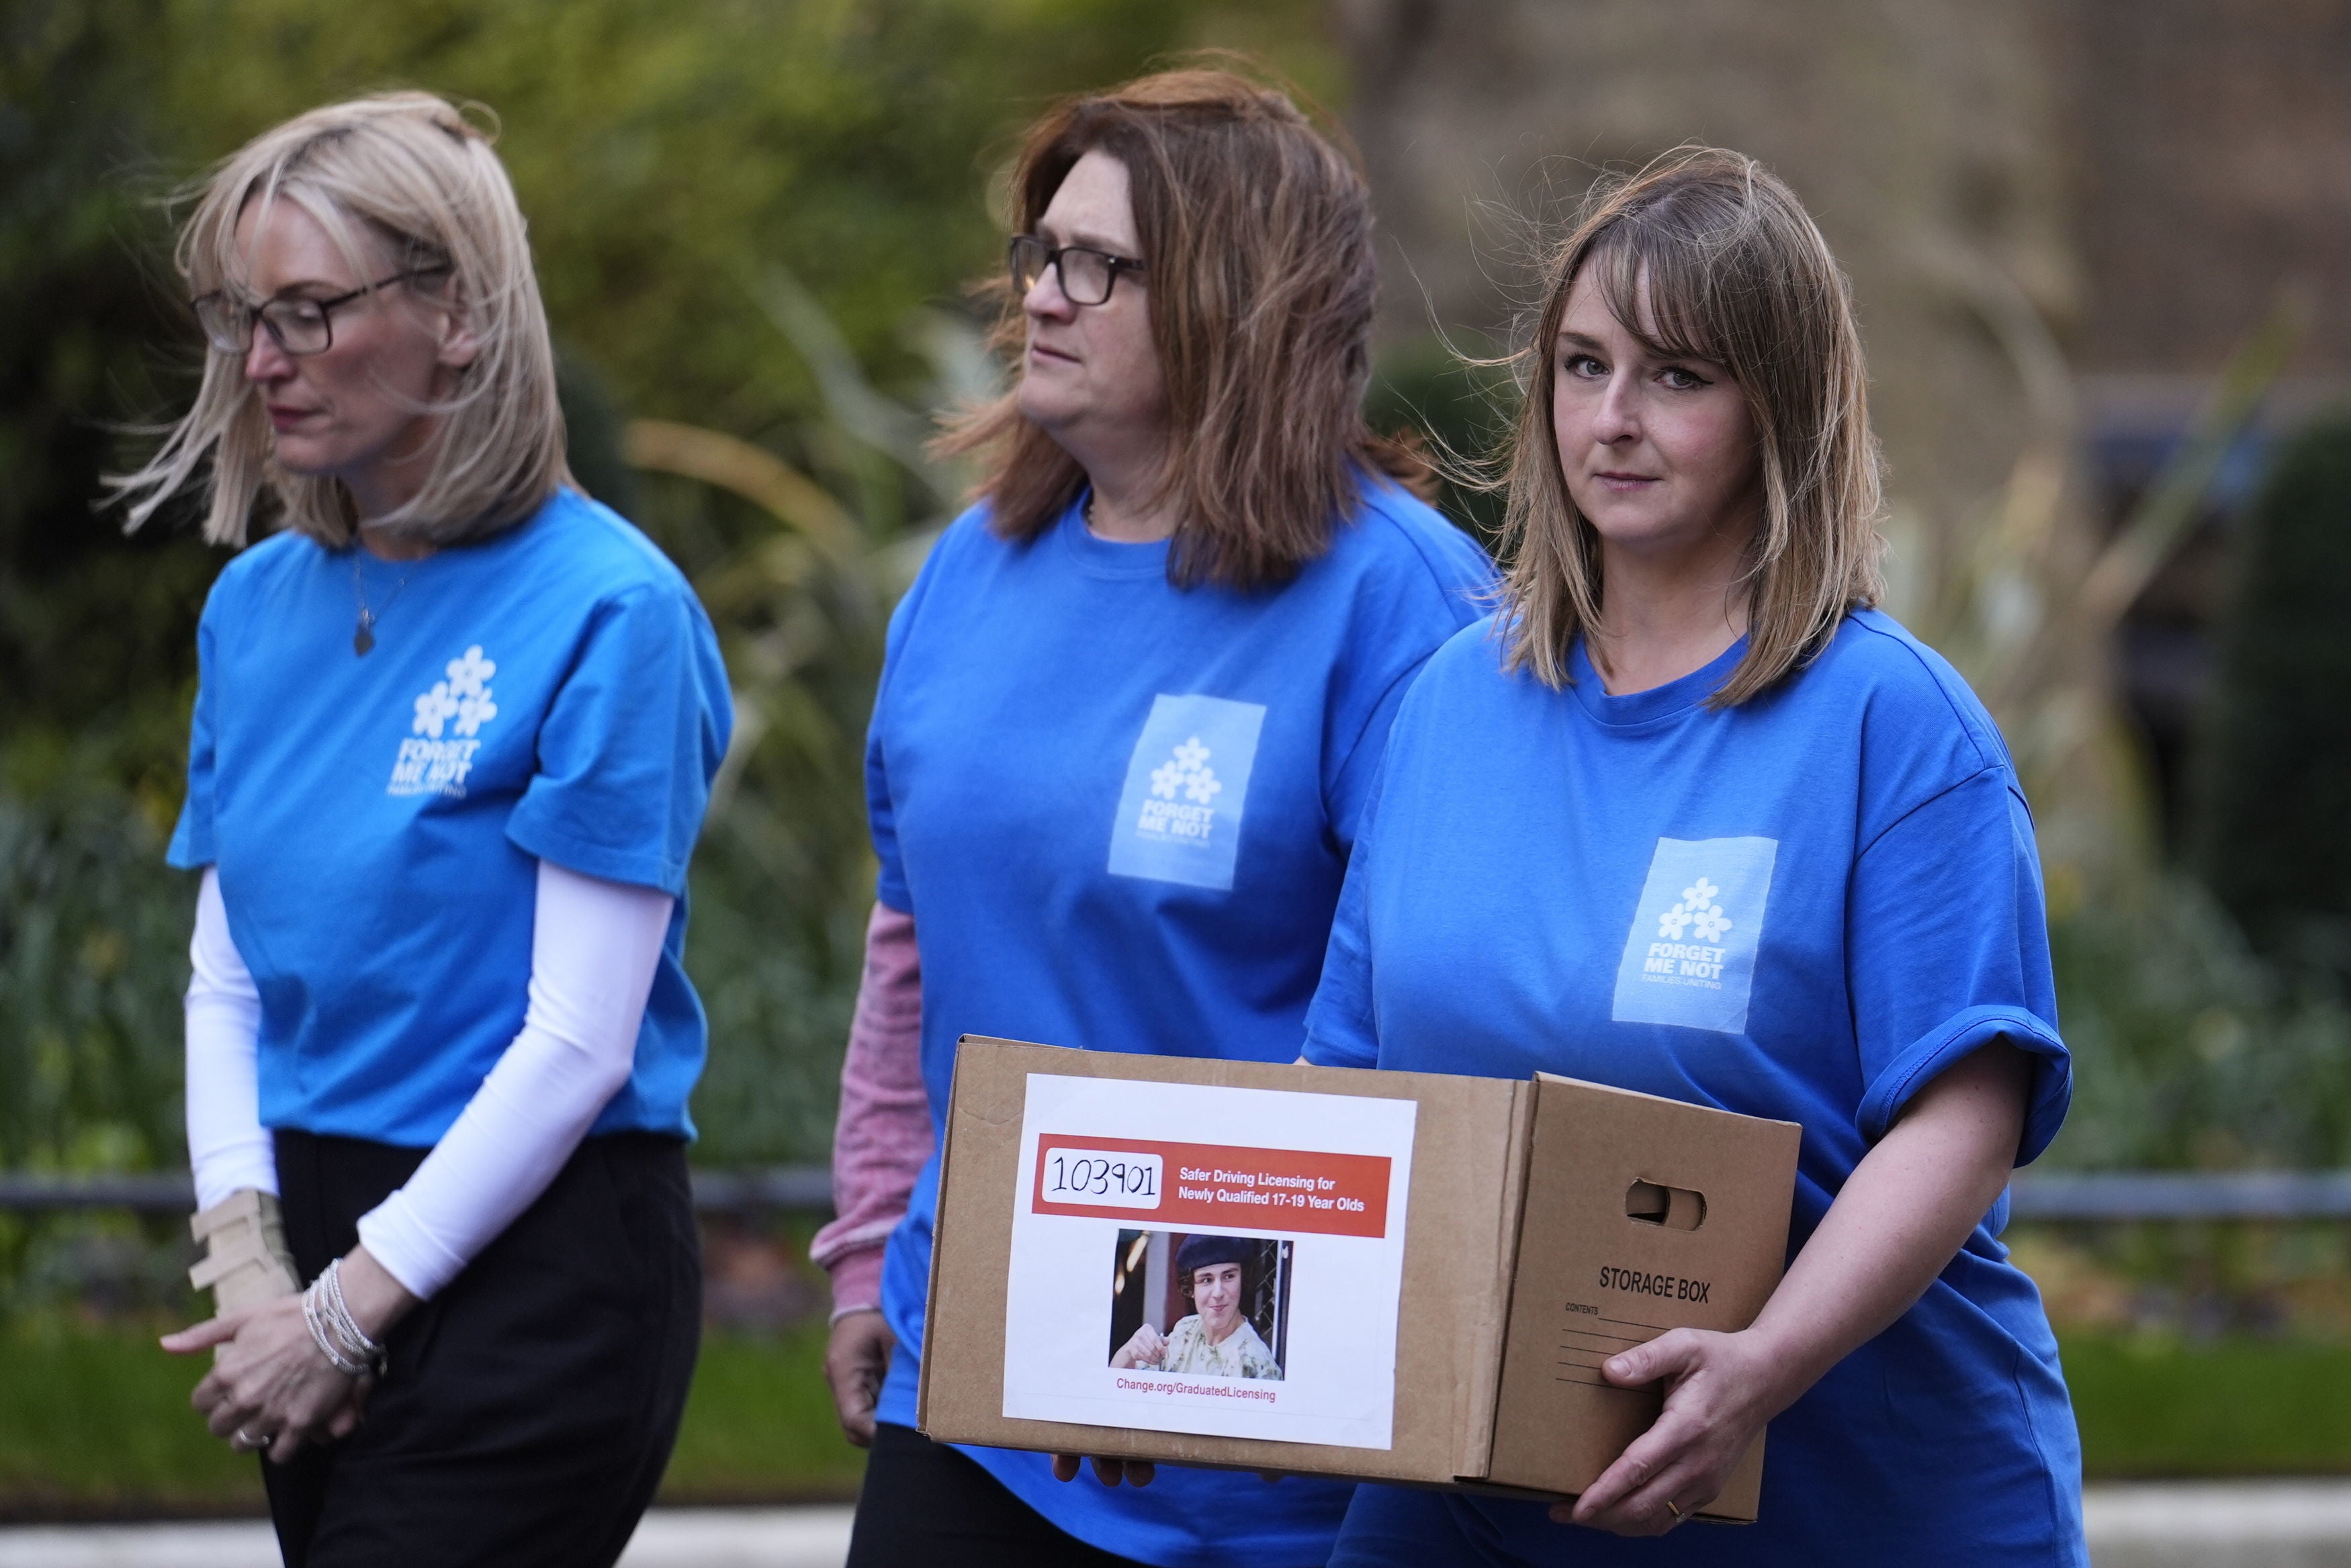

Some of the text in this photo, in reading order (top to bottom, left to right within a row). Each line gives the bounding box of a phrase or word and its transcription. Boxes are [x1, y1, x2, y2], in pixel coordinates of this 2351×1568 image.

[1143, 799, 1214, 823] FORGET
[1138, 815, 1167, 832] ME
[1171, 819, 1212, 839] NOT
[1648, 942, 1726, 963] FORGET
[1644, 958, 1724, 979] ME NOT
[1641, 974, 1721, 990] FAMILIES UNITING
[1051, 1156, 1155, 1195] 103901
[1180, 1166, 1335, 1192] Safer Driving Licensing for
[1178, 1186, 1365, 1212] Newly Qualified 17-19 Year Olds
[1599, 1266, 1711, 1304] STORAGE BOX
[1565, 1302, 1599, 1316] CONTENTS
[1116, 1377, 1276, 1403] Change.org/GraduatedLicensing
